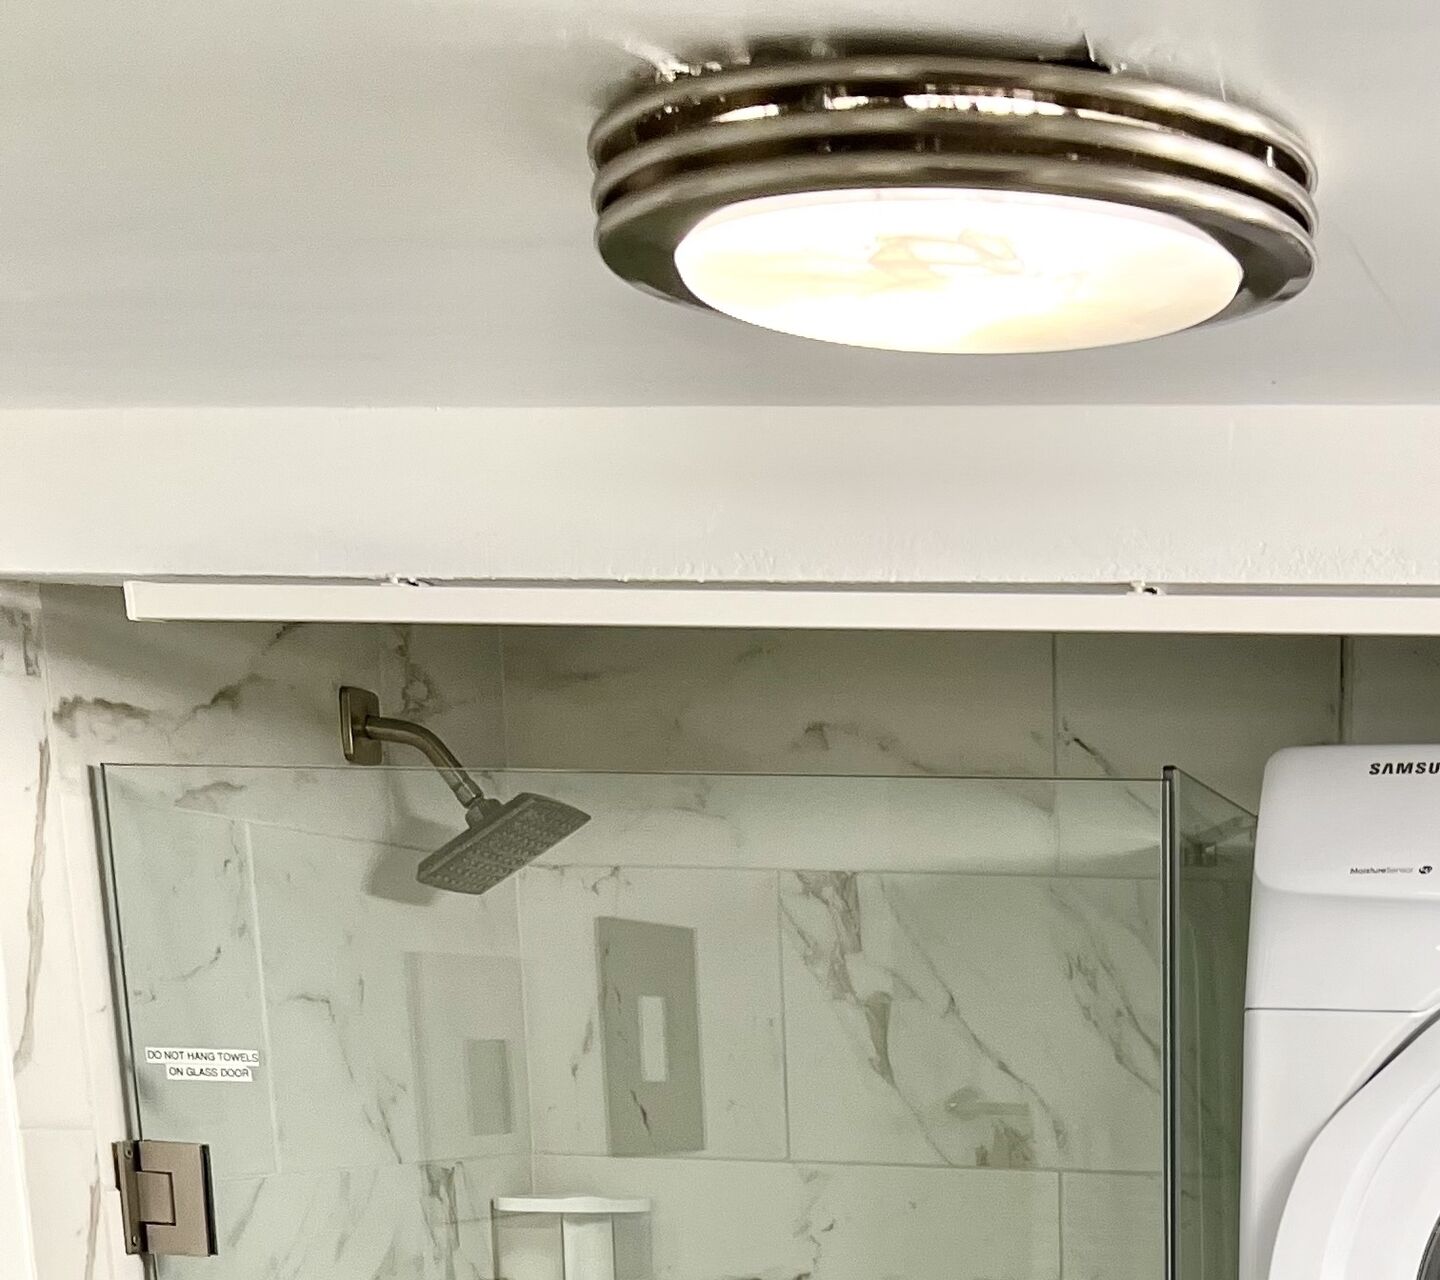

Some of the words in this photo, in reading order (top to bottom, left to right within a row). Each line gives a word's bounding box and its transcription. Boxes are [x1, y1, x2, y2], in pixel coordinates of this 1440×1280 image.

[147, 1050, 162, 1060] DO
[164, 1051, 184, 1060] NOT
[187, 1052, 215, 1061] HANG
[217, 1052, 258, 1062] TOWELS
[168, 1067, 183, 1076] ON
[186, 1068, 218, 1077] GLASS
[221, 1068, 249, 1078] DOOR
